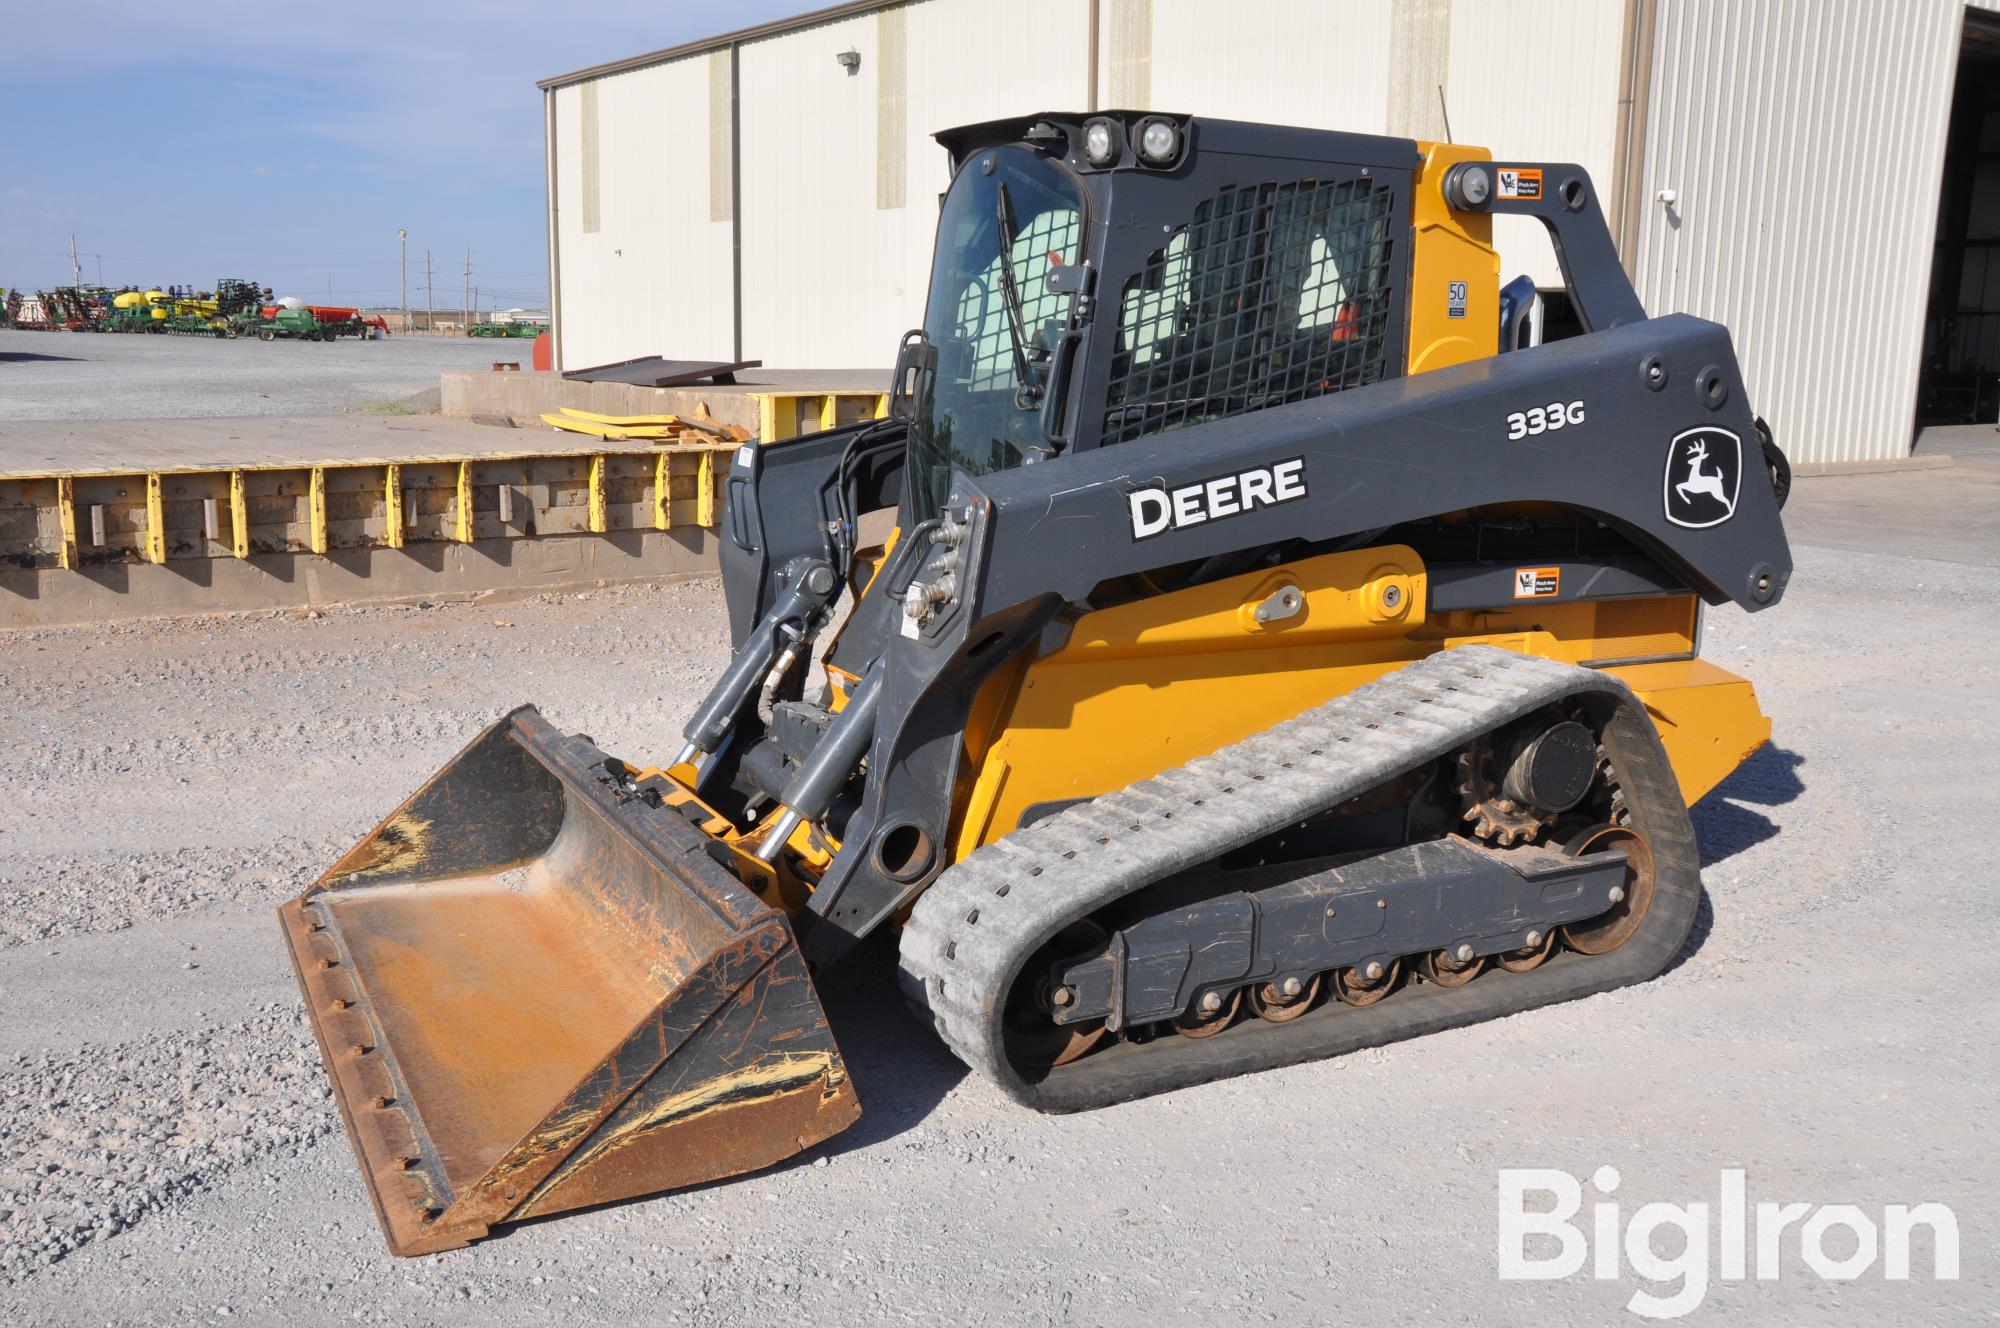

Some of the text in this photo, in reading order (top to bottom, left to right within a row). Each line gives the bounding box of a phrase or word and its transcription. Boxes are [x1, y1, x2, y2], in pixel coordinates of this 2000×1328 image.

[1450, 283, 1465, 300] 50
[1507, 400, 1585, 440] 333G
[1129, 459, 1306, 539] DEERE
